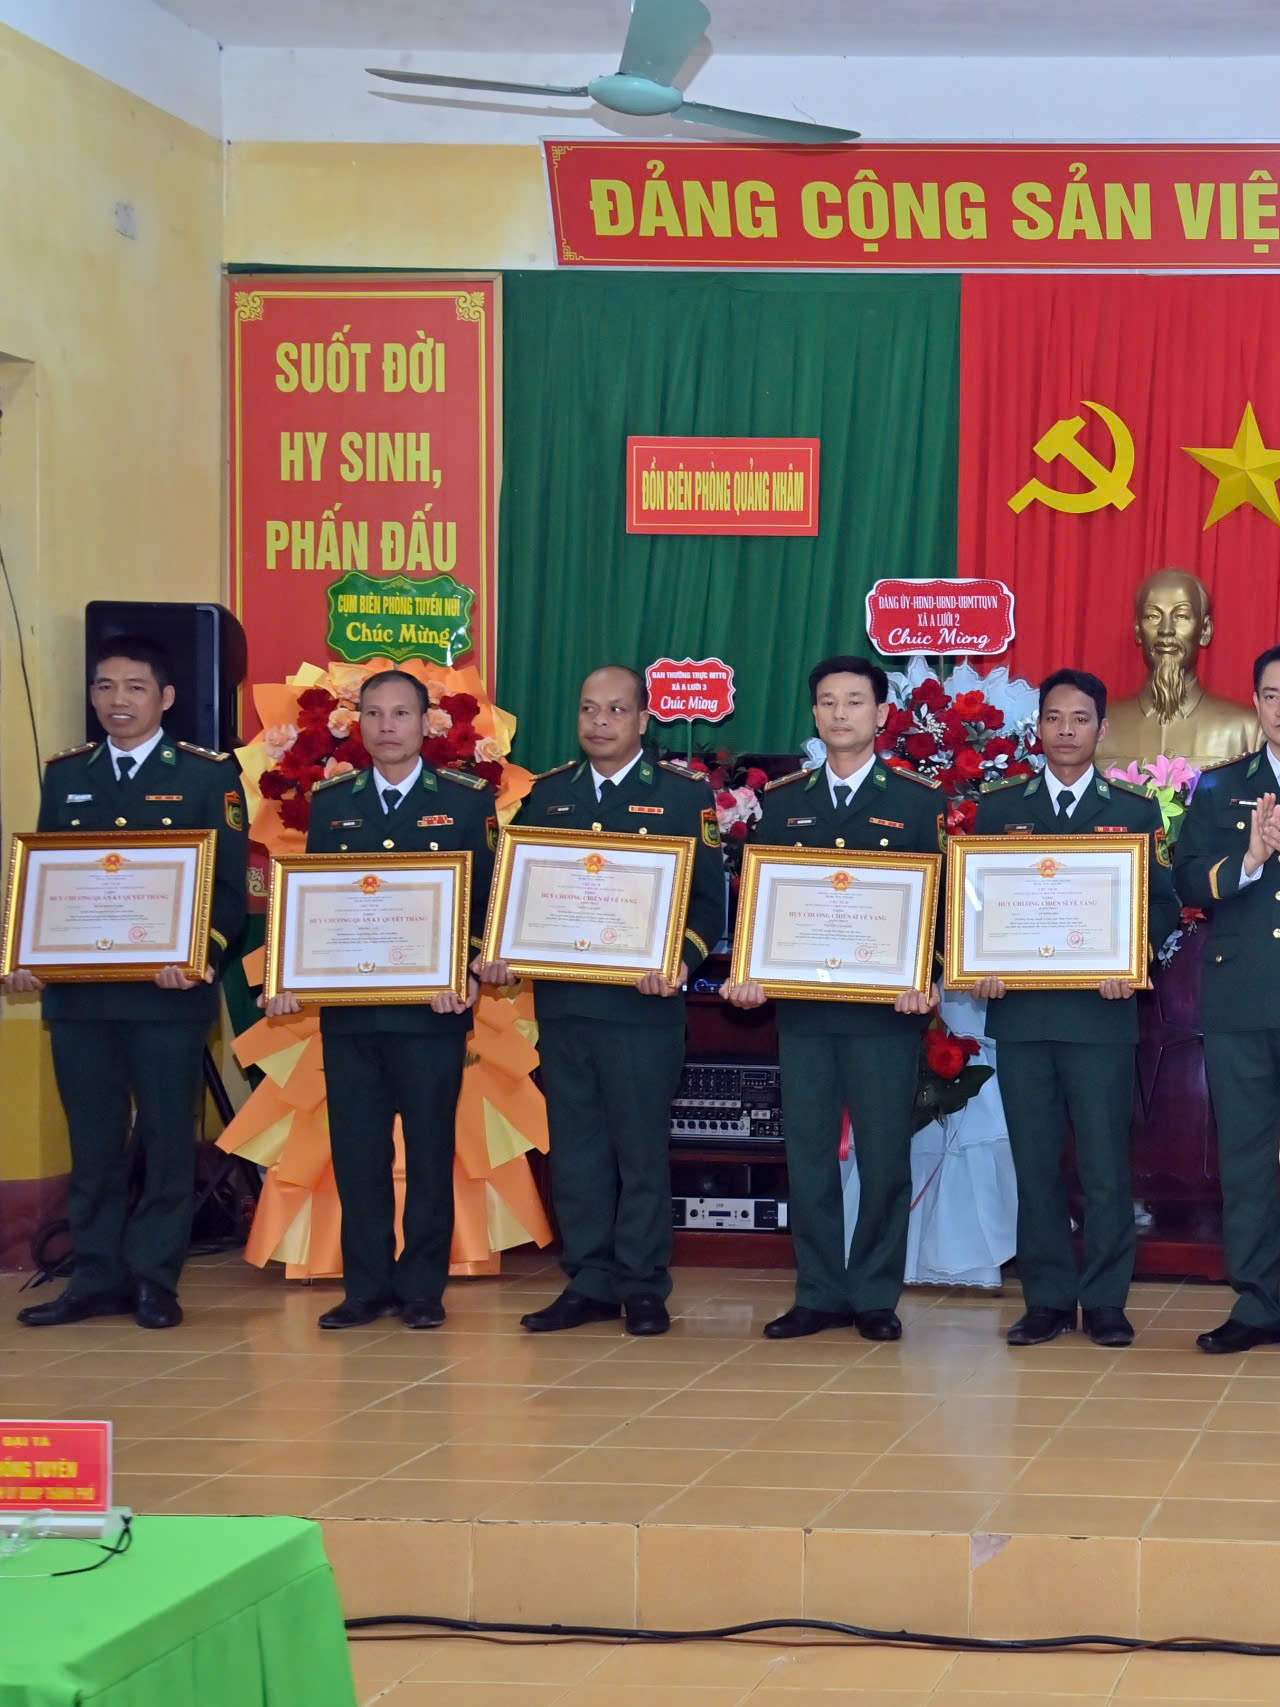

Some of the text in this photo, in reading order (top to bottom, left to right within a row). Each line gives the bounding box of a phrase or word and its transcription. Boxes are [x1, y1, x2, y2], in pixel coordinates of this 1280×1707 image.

[590, 160, 777, 238] ĐẢNG
[801, 169, 986, 253] CỘNG
[1012, 162, 1151, 239] SẢN
[275, 324, 445, 393] SUỐT ĐỜI
[280, 431, 442, 488] HY SINH,
[734, 457, 769, 516] QUẢNG
[266, 503, 457, 571] PHẤN ĐẤU
[346, 622, 450, 648] Chúc Mừng
[888, 628, 990, 649] Chúc Mừng
[930, 614, 936, 626] A
[955, 614, 960, 626] 2
[660, 695, 718, 713] Chúc Mừng
